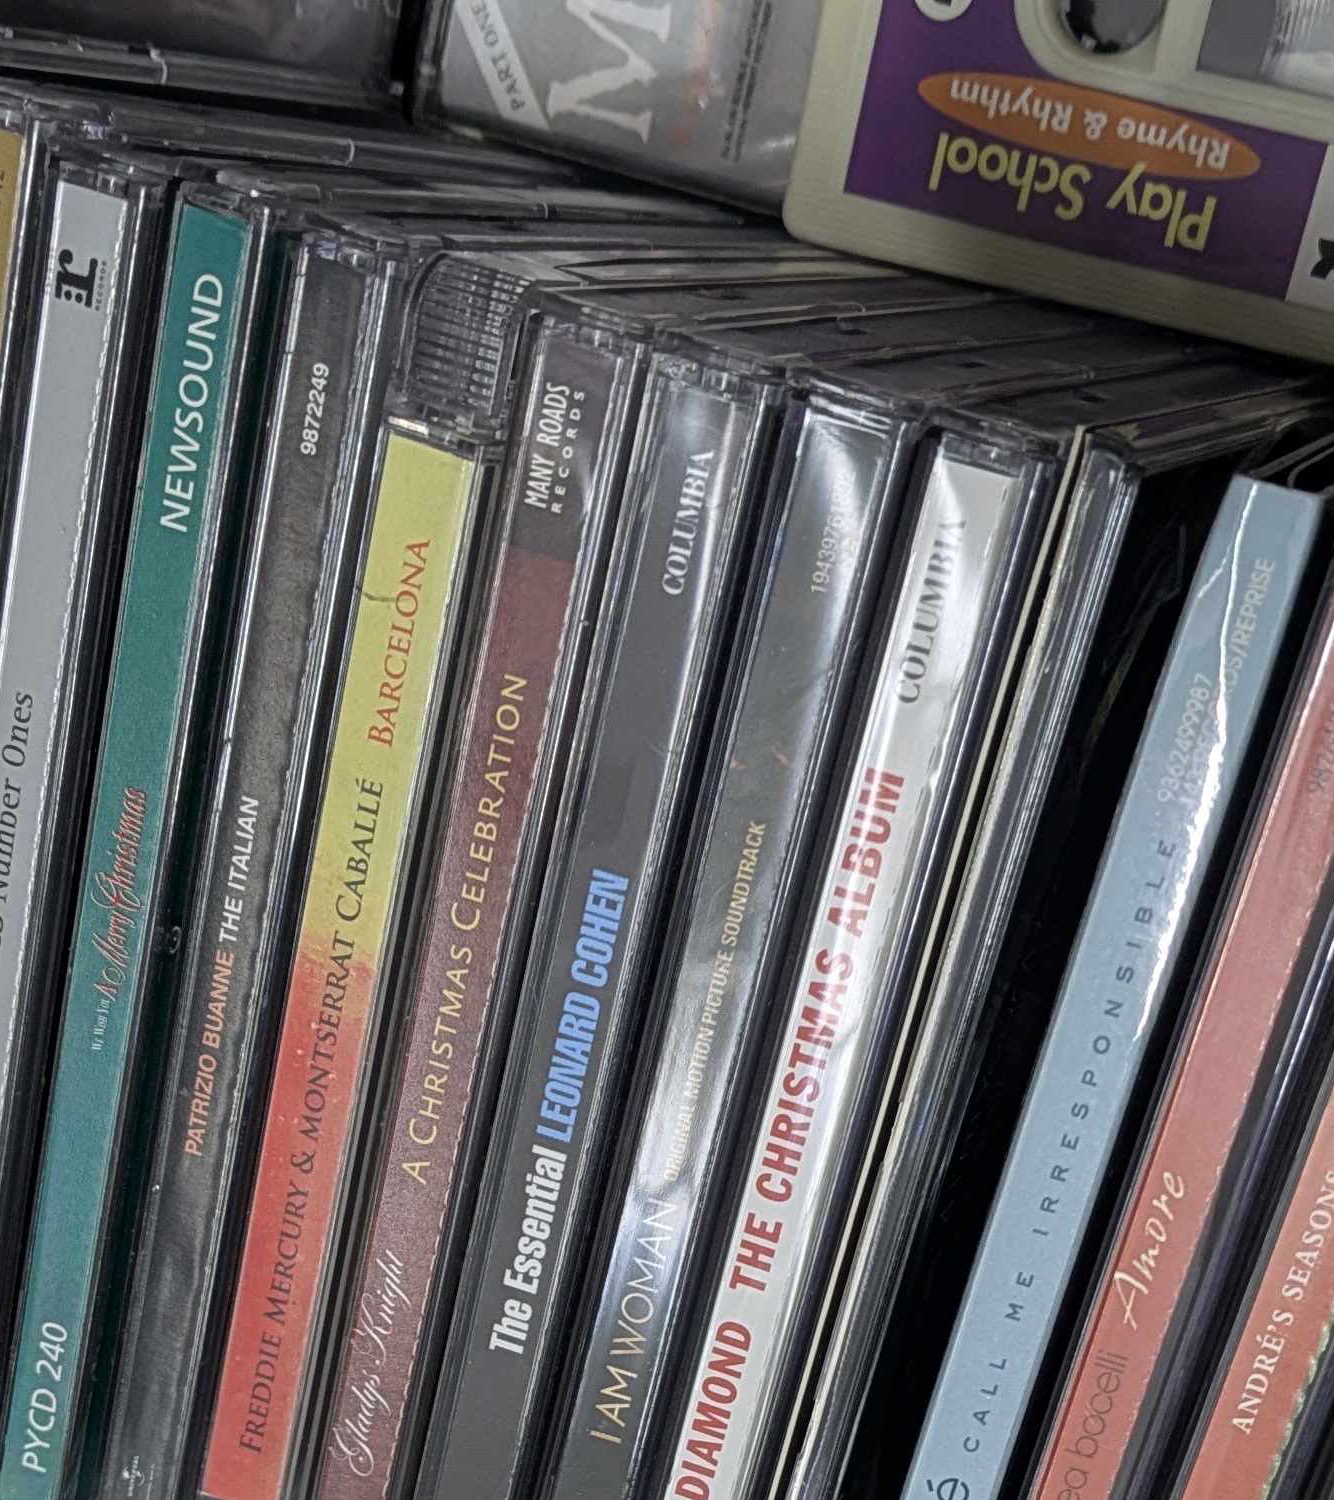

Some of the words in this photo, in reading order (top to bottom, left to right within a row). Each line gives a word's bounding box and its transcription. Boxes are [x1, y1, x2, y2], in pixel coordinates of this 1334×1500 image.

[950, 78, 1073, 132] Rhythm
[1117, 117, 1230, 171] Rhyme
[929, 132, 1091, 220] School
[1107, 162, 1216, 251] Play
[160, 275, 222, 530] NEWSOUND
[300, 363, 328, 454] 9872249
[536, 380, 571, 445] ROADS
[522, 453, 557, 508] MANY
[368, 541, 429, 745] BARCELONA
[1, 692, 32, 767] Ones
[90, 789, 146, 911] Christmas
[228, 796, 258, 890] ITALIAN
[721, 822, 764, 946] SOUNDTRACK
[567, 867, 630, 990] COHEN
[199, 948, 233, 1048] BUANNE
[729, 1213, 781, 1290] THE
[756, 950, 831, 1201] CHRISTMAS
[828, 768, 903, 938] ALBUM
[184, 1051, 218, 1155] PATRIZIO
[534, 989, 602, 1144] LEONARD
[239, 1331, 281, 1452] FREDDIE
[263, 1181, 307, 1324] MERCURY
[300, 929, 357, 1140] MONTSERRAT
[501, 1143, 568, 1295] Essential
[488, 1296, 534, 1356] The
[609, 1199, 680, 1362] WOMAN
[35, 1322, 67, 1381] 240
[22, 1388, 56, 1472] PYCD
[1065, 1352, 1127, 1458] bocelli
